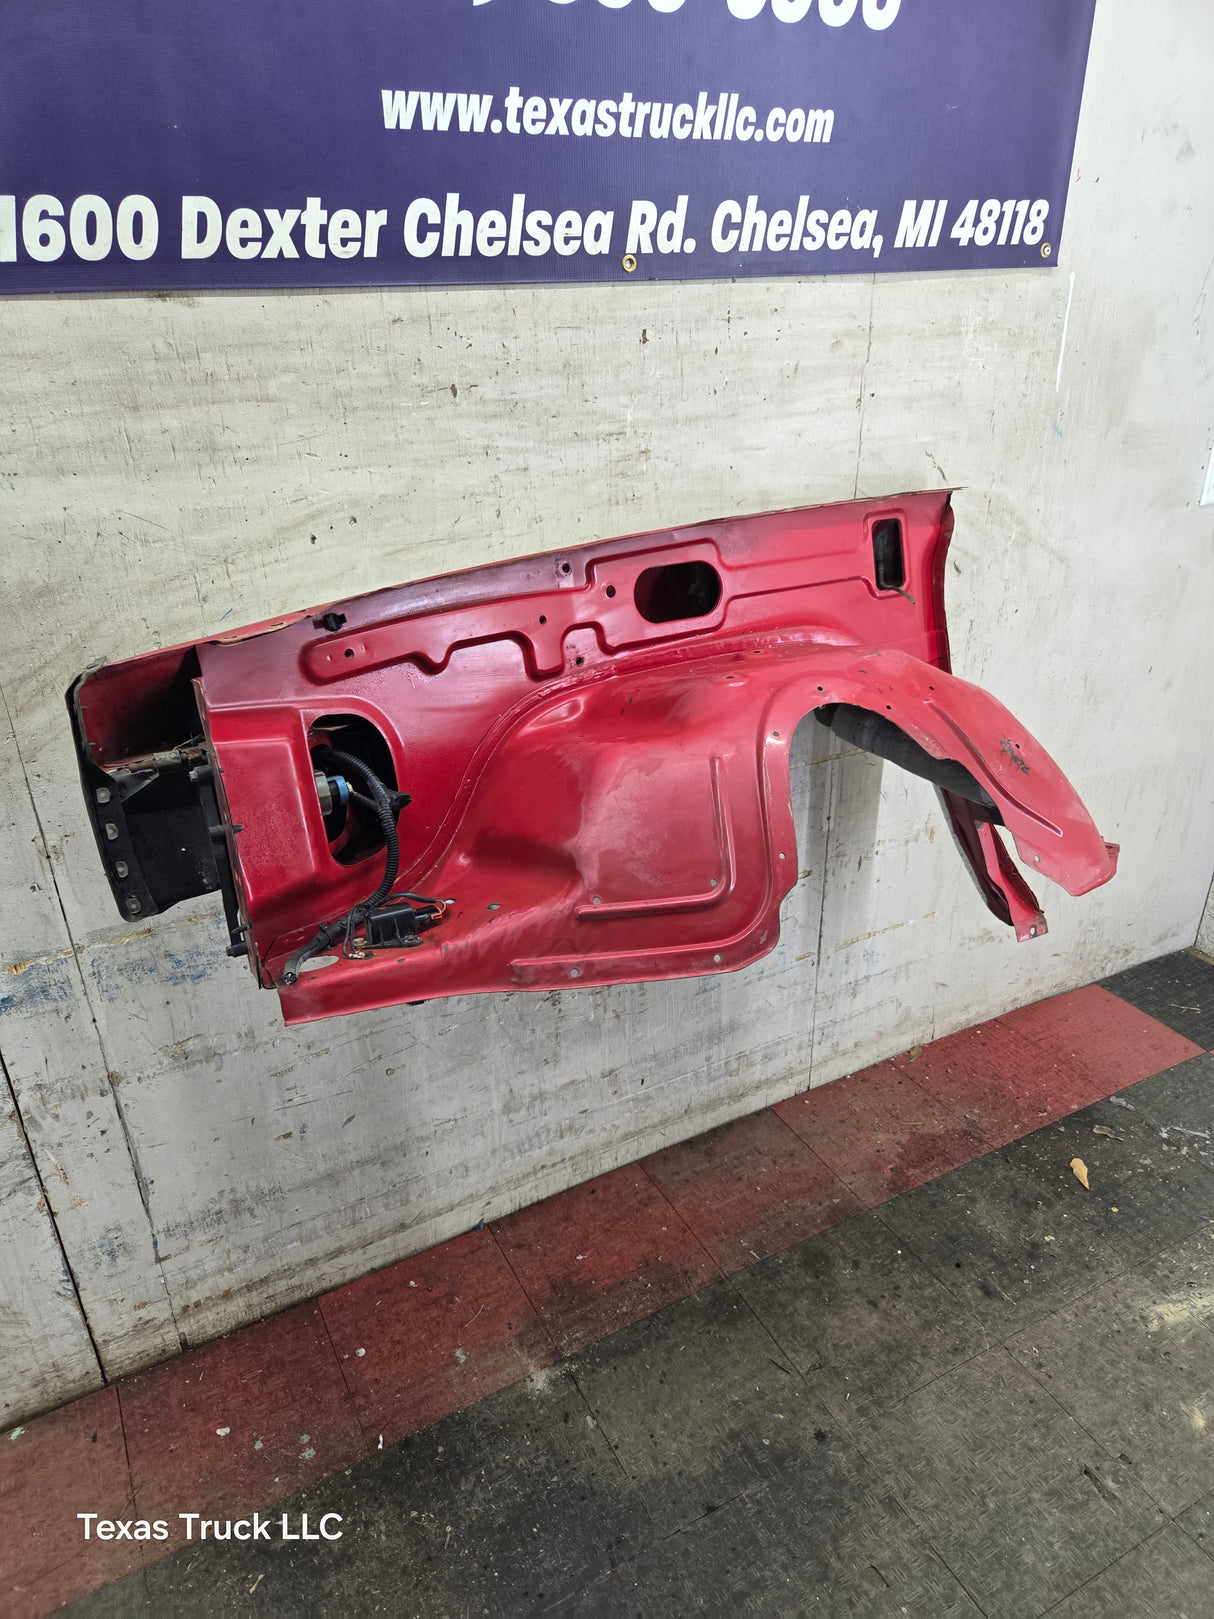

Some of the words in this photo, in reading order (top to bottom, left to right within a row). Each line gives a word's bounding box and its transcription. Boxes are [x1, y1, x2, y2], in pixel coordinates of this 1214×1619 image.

[381, 86, 835, 144] www.texastruckllc.com
[181, 195, 389, 260] Dexter
[403, 192, 615, 258] Chelsea
[625, 194, 697, 255] Rd.
[710, 194, 884, 259] Chelsea,
[893, 198, 950, 249] MI
[949, 198, 1050, 247] 48118
